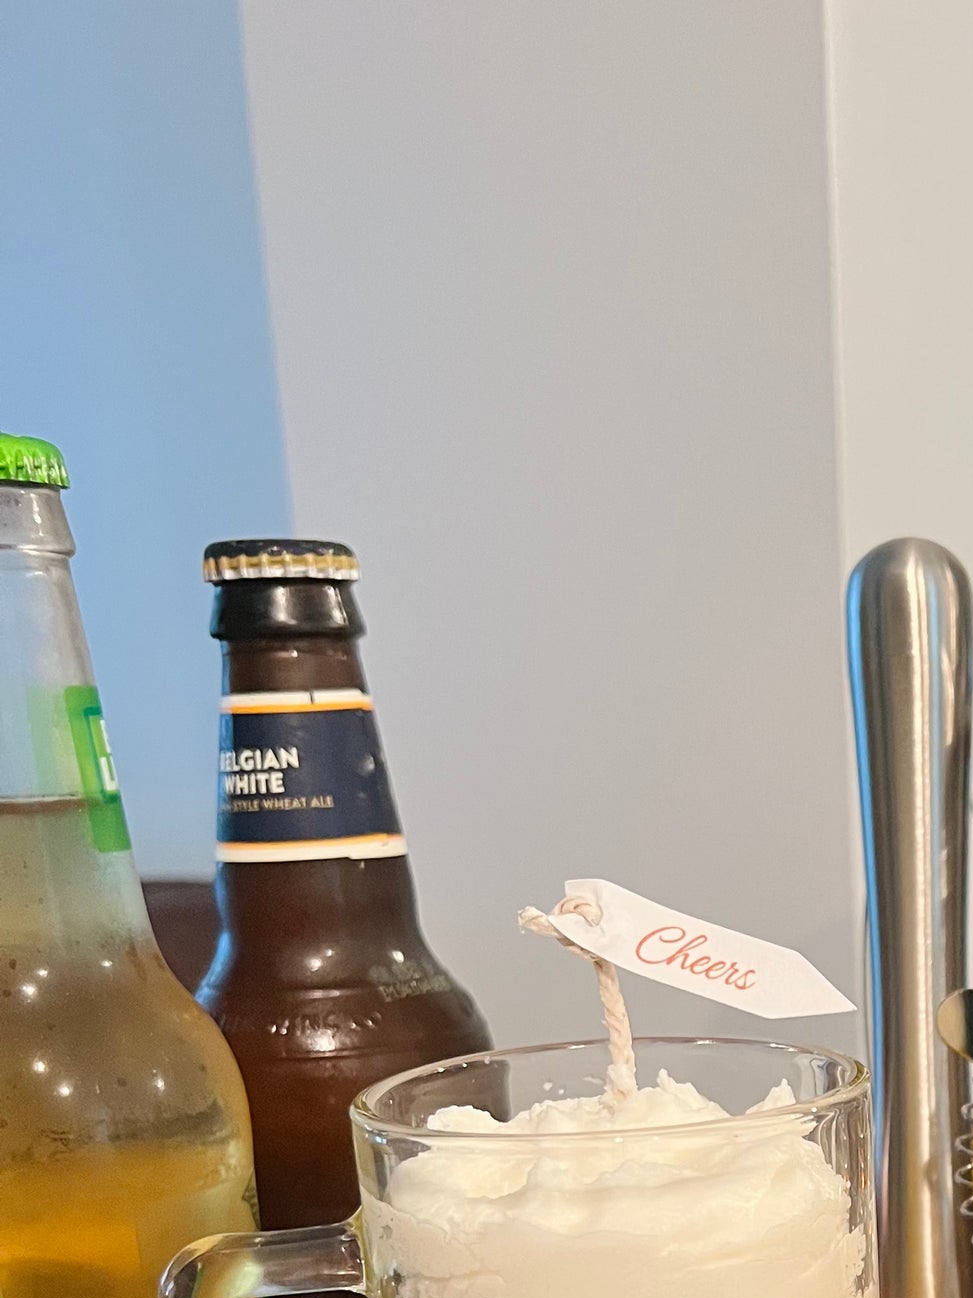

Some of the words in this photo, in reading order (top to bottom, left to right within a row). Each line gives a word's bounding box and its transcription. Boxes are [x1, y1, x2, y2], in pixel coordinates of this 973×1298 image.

[225, 771, 285, 794] WHITE
[263, 797, 307, 810] WHEAT
[310, 795, 334, 808] ALE
[635, 926, 757, 991] Cheers
